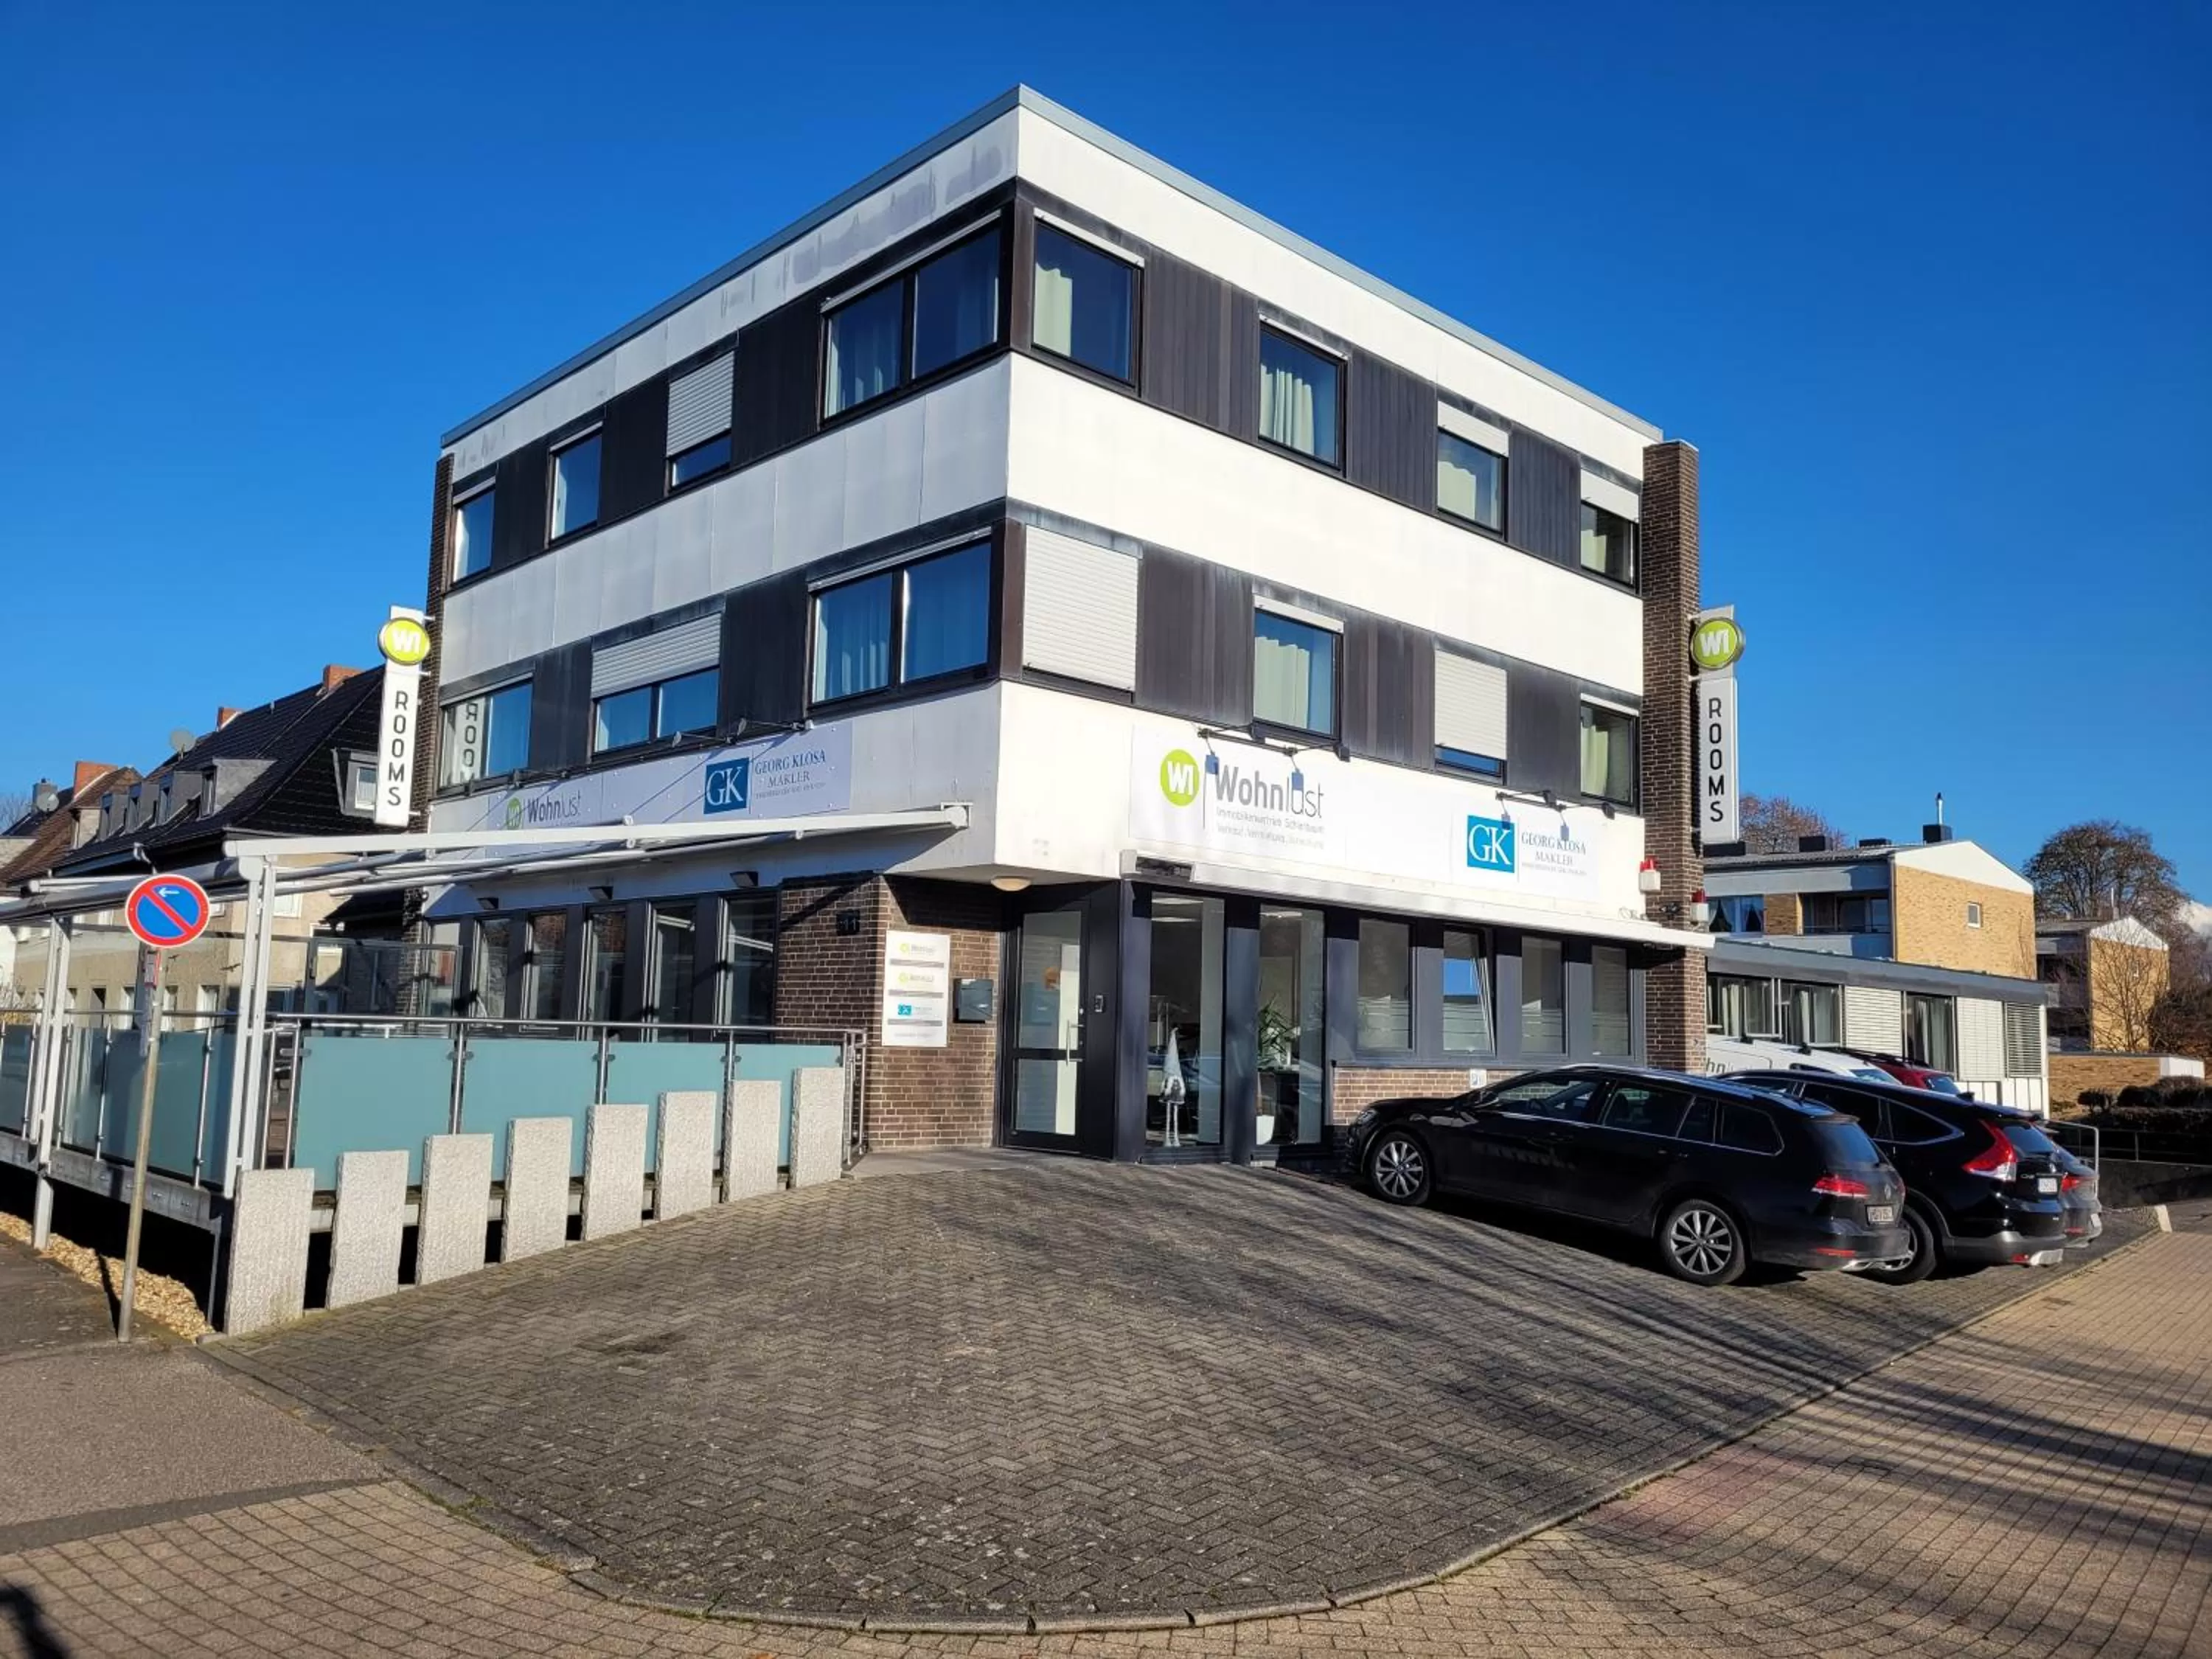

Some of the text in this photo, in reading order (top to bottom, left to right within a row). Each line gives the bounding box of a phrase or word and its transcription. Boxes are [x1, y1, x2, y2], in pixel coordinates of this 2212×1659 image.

[387, 691, 408, 807] ROOMS
[755, 749, 825, 774] GEORG KLOSA
[1708, 698, 1724, 822] ROOMS
[706, 766, 744, 806] GK
[767, 771, 810, 788] MAKLER
[1216, 764, 1324, 818] Wohnlust
[527, 790, 581, 823] Wohnlust
[1468, 824, 1511, 865] GK
[1521, 831, 1586, 855] GEORG KLOSA
[1535, 851, 1574, 866] MAKLER
